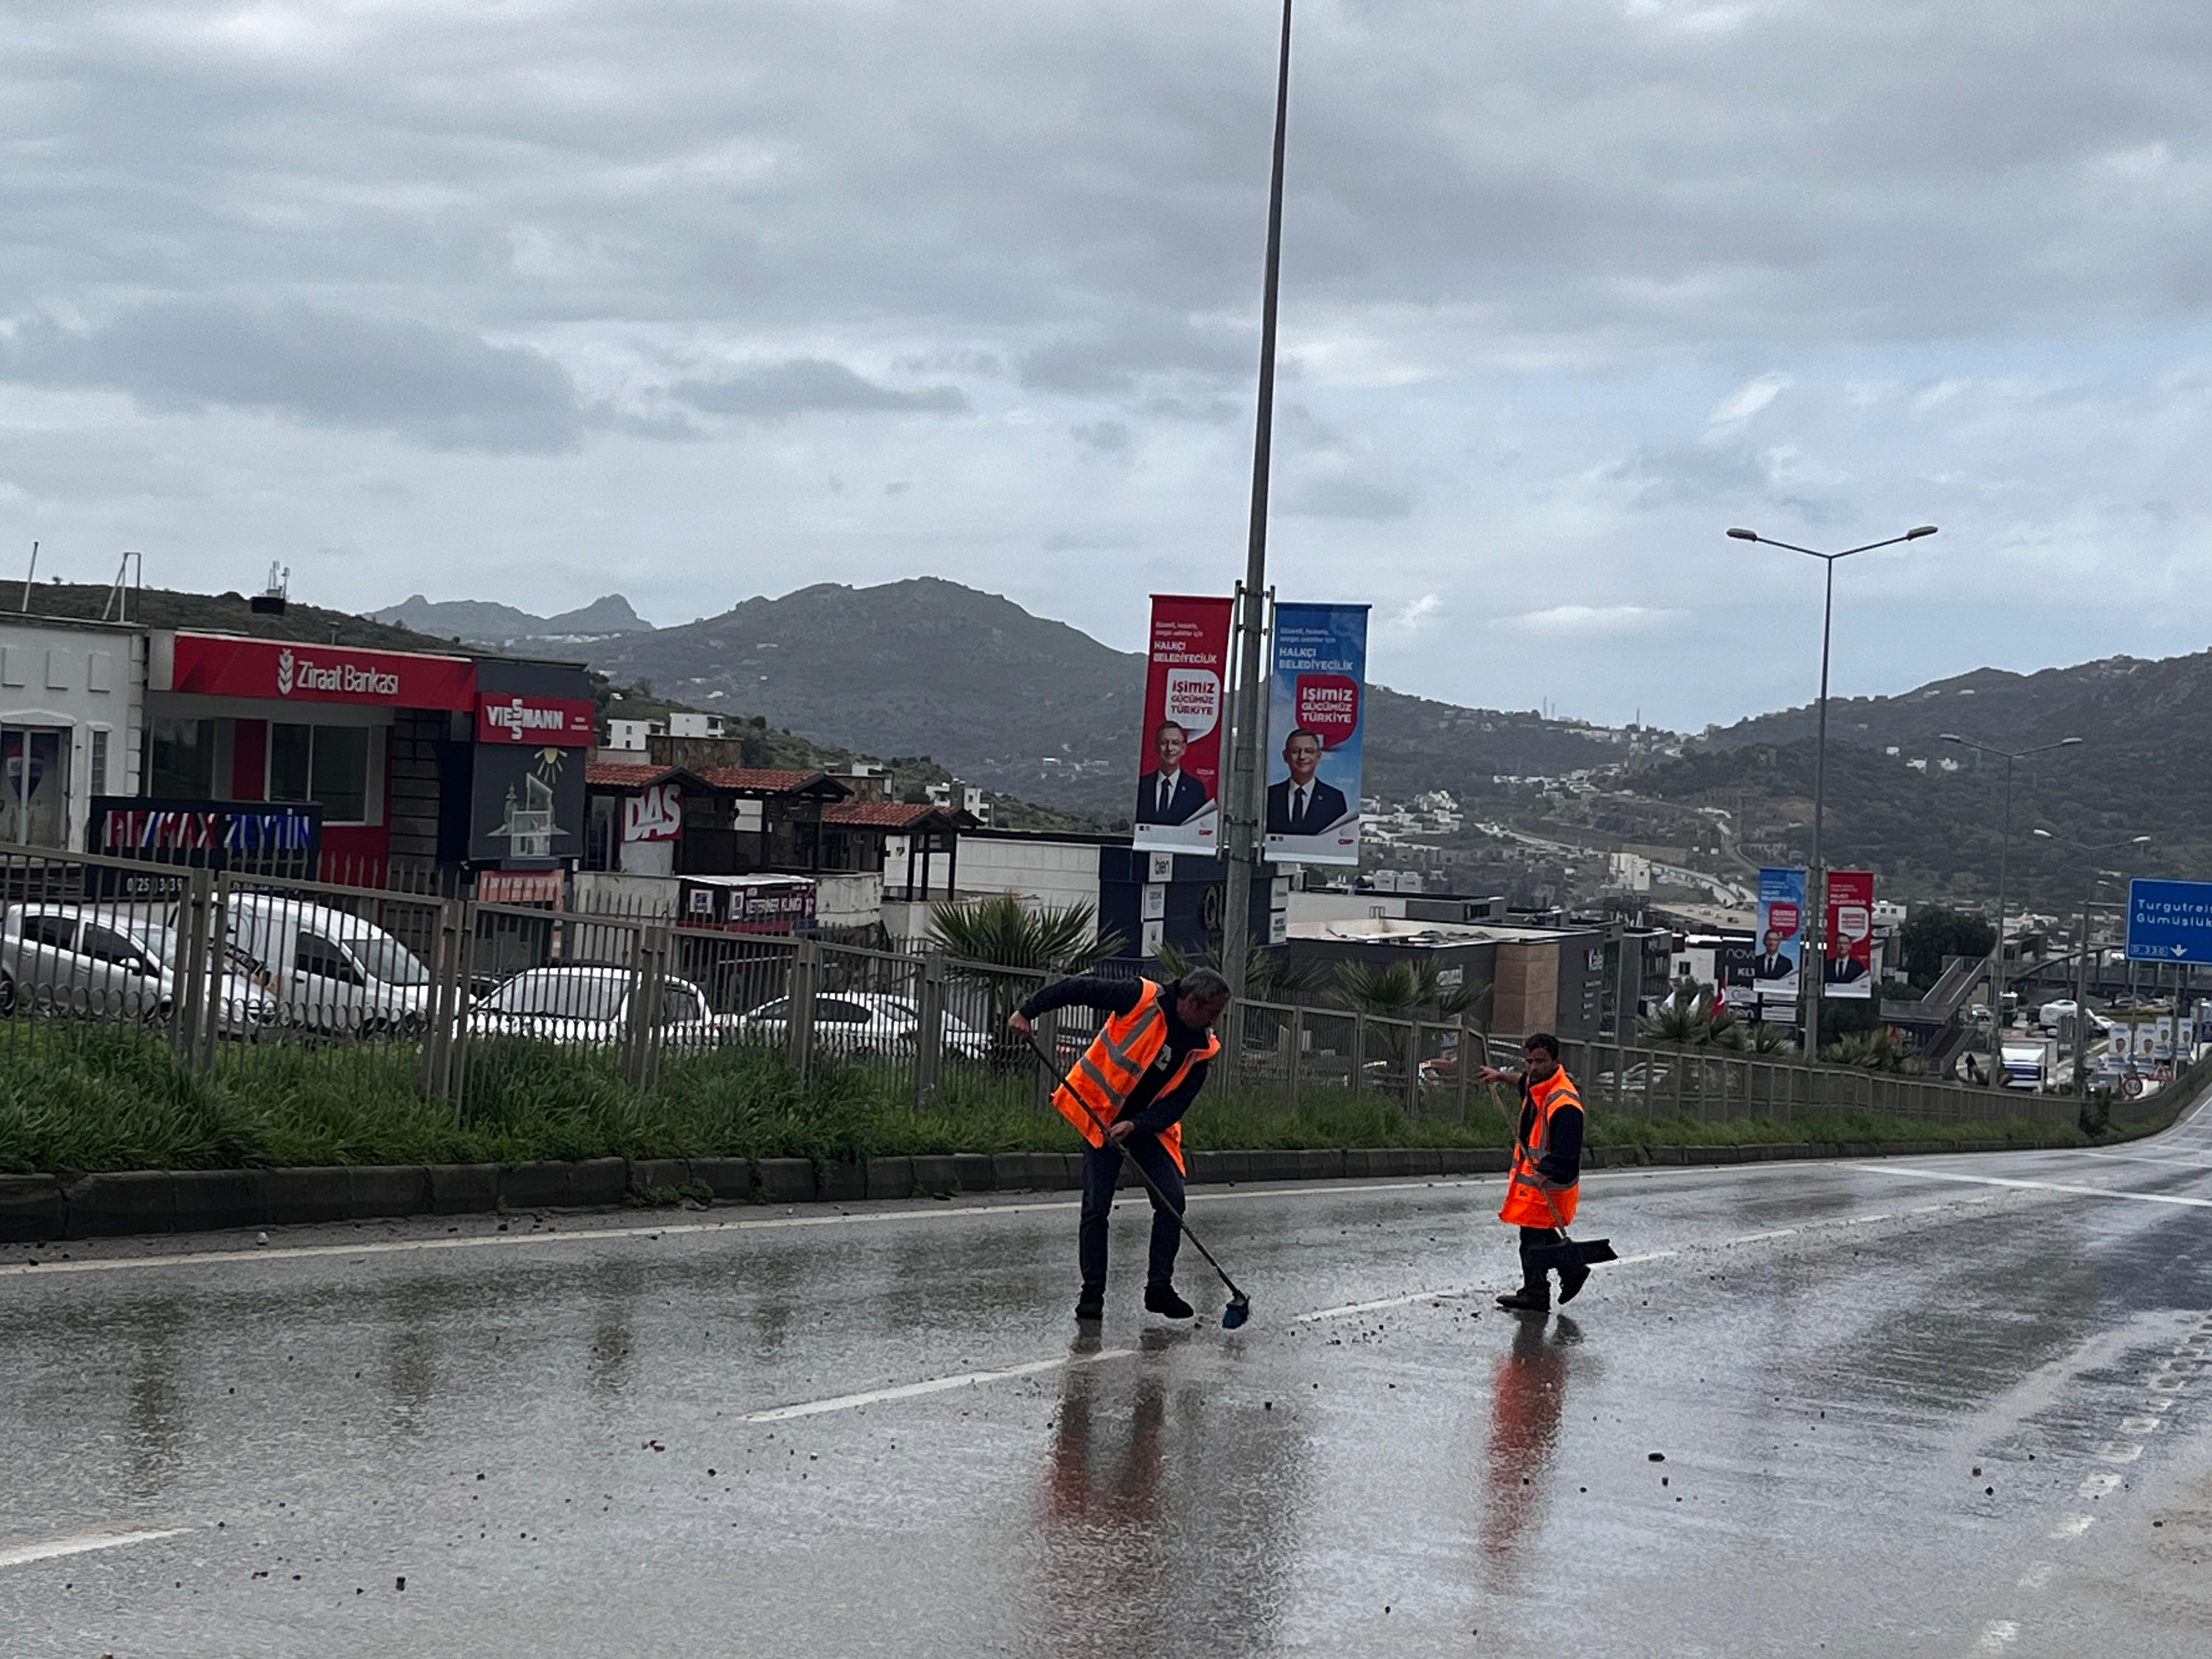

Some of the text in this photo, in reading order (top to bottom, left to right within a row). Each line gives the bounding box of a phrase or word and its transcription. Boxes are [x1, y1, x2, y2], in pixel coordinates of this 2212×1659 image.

[1279, 647, 1316, 658] HALKÇI
[1279, 659, 1353, 670] BELEDİYECİLİK
[297, 660, 399, 695] Ziraat Bankası
[1171, 704, 1213, 715] TÜRKİYE
[1301, 712, 1351, 724] TÜRKİYE
[625, 784, 681, 842] DAS
